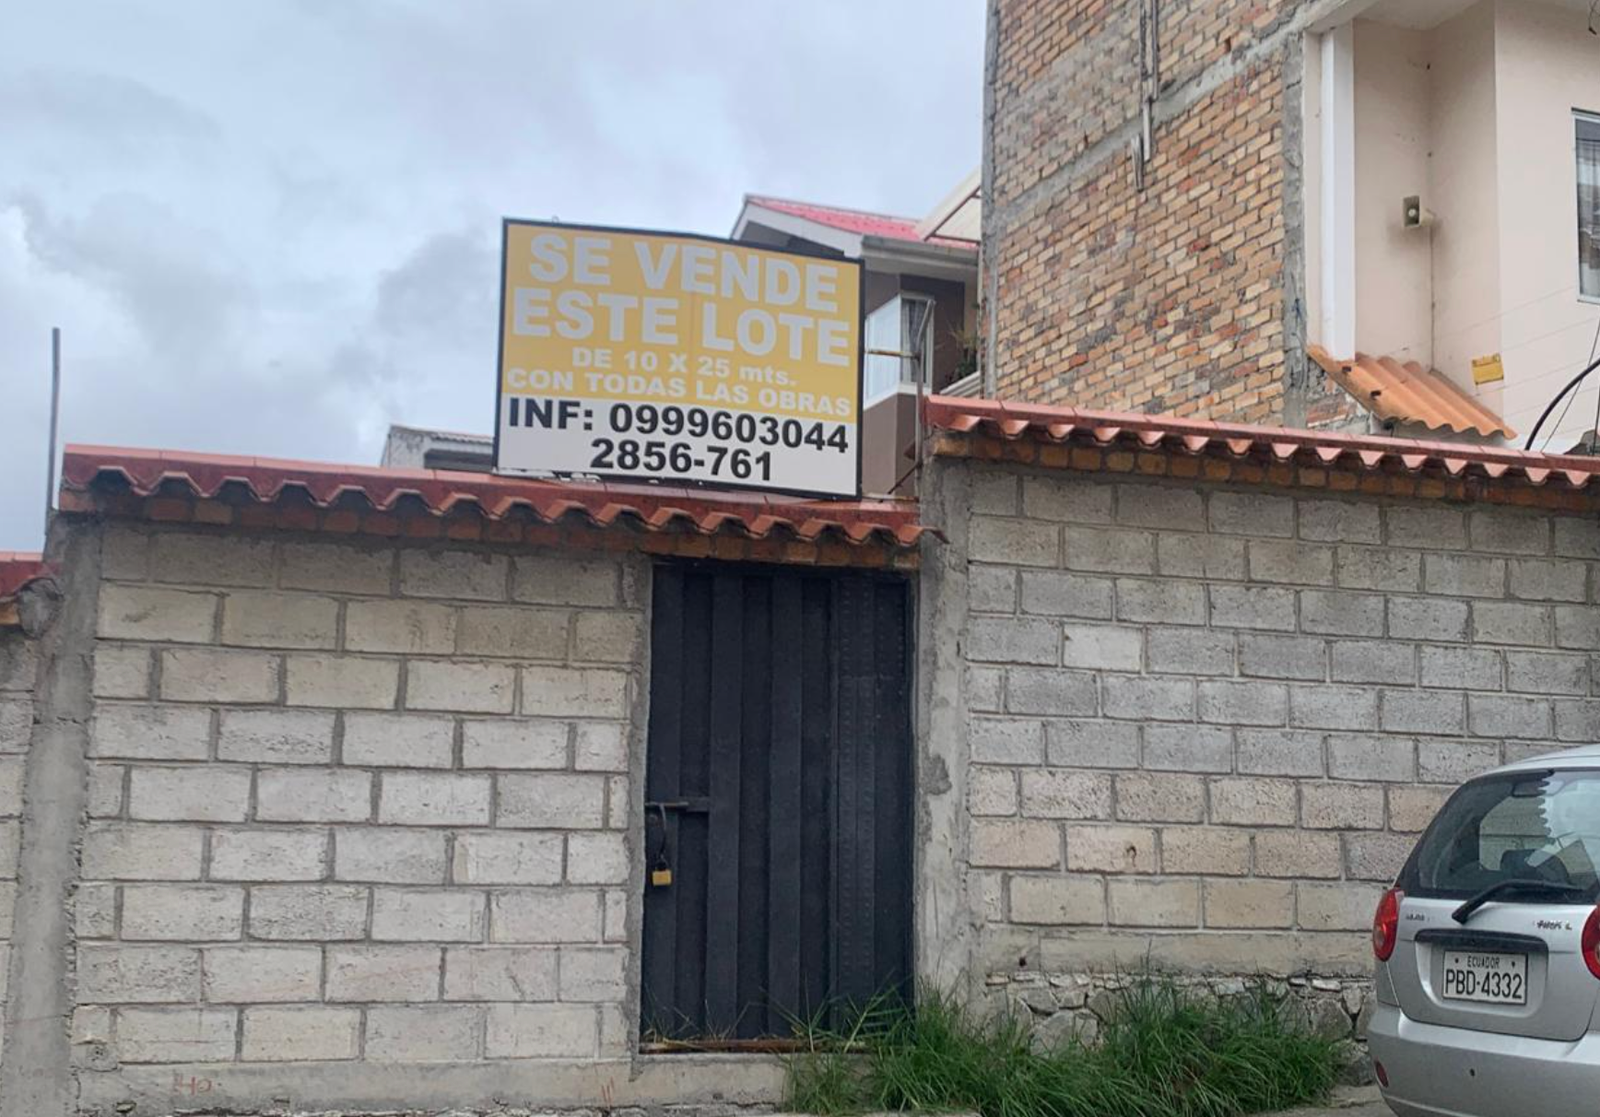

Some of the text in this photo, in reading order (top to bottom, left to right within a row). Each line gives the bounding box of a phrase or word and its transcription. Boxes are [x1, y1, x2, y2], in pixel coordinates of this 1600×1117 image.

[530, 233, 837, 313] SE VENDE
[513, 287, 850, 366] ESTE LOTE
[572, 347, 798, 386] DE 10 X 25 mts.
[507, 368, 851, 417] CON TODAS LAS OBRAS
[508, 397, 849, 453] INF: 0999603044
[590, 438, 772, 481] 2856-761
[1467, 955, 1500, 969] ECUADOR
